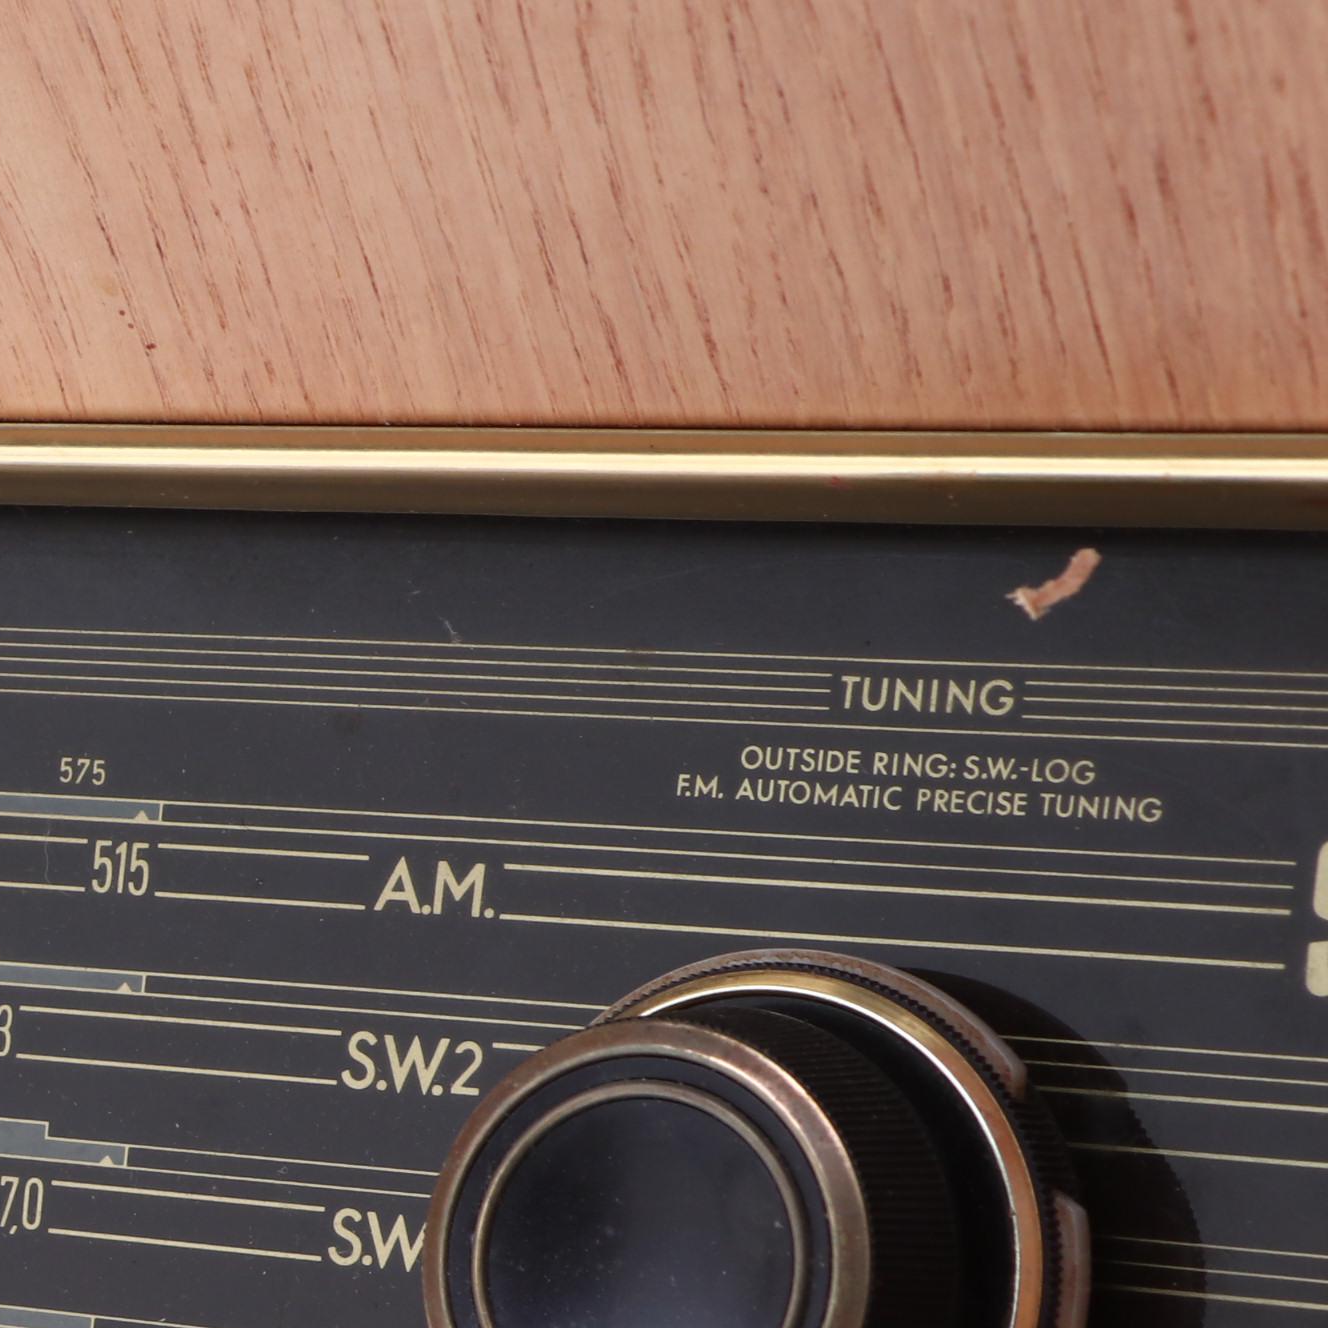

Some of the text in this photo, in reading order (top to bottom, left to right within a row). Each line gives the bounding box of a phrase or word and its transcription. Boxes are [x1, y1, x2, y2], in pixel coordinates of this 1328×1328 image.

[841, 676, 1015, 716] TUNING
[60, 759, 106, 785] 575
[741, 746, 1096, 784] OUTSIDE RING: S.W.-LOG
[677, 774, 1163, 823] F.M. AUTOMATIC PRECISE TUNING
[92, 841, 150, 895] 515
[373, 857, 495, 918] A.M.
[0, 1176, 44, 1236] 7,0
